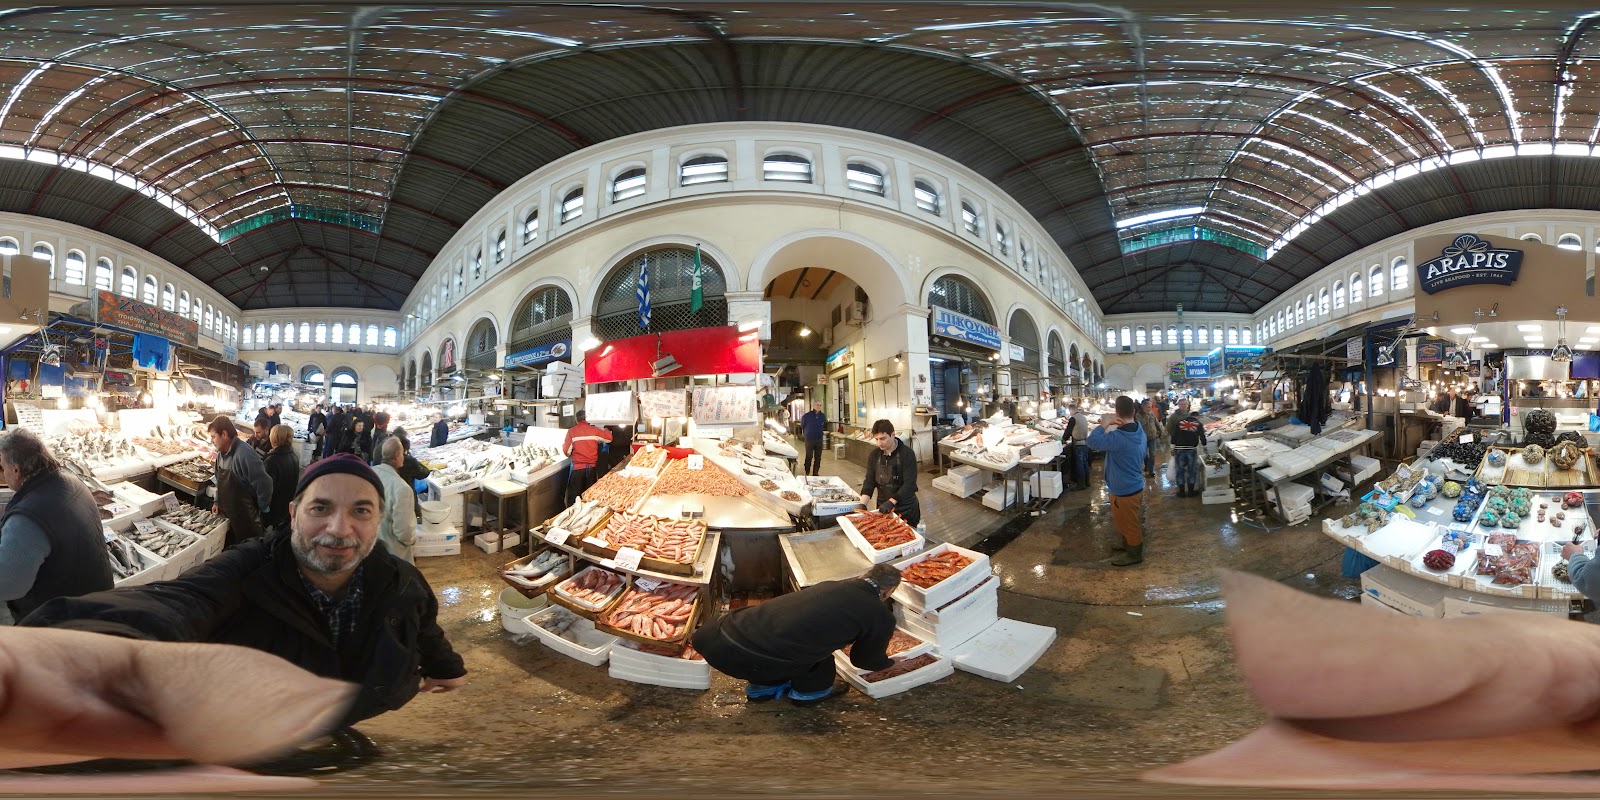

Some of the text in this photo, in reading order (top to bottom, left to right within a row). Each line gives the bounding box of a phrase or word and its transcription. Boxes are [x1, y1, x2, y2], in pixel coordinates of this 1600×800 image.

[1426, 252, 1509, 279] ARAPIS
[940, 311, 1000, 338] ΠΙΚΟΥΝΗΣ
[1185, 359, 1209, 367] ΦΡΕΣΚΑ
